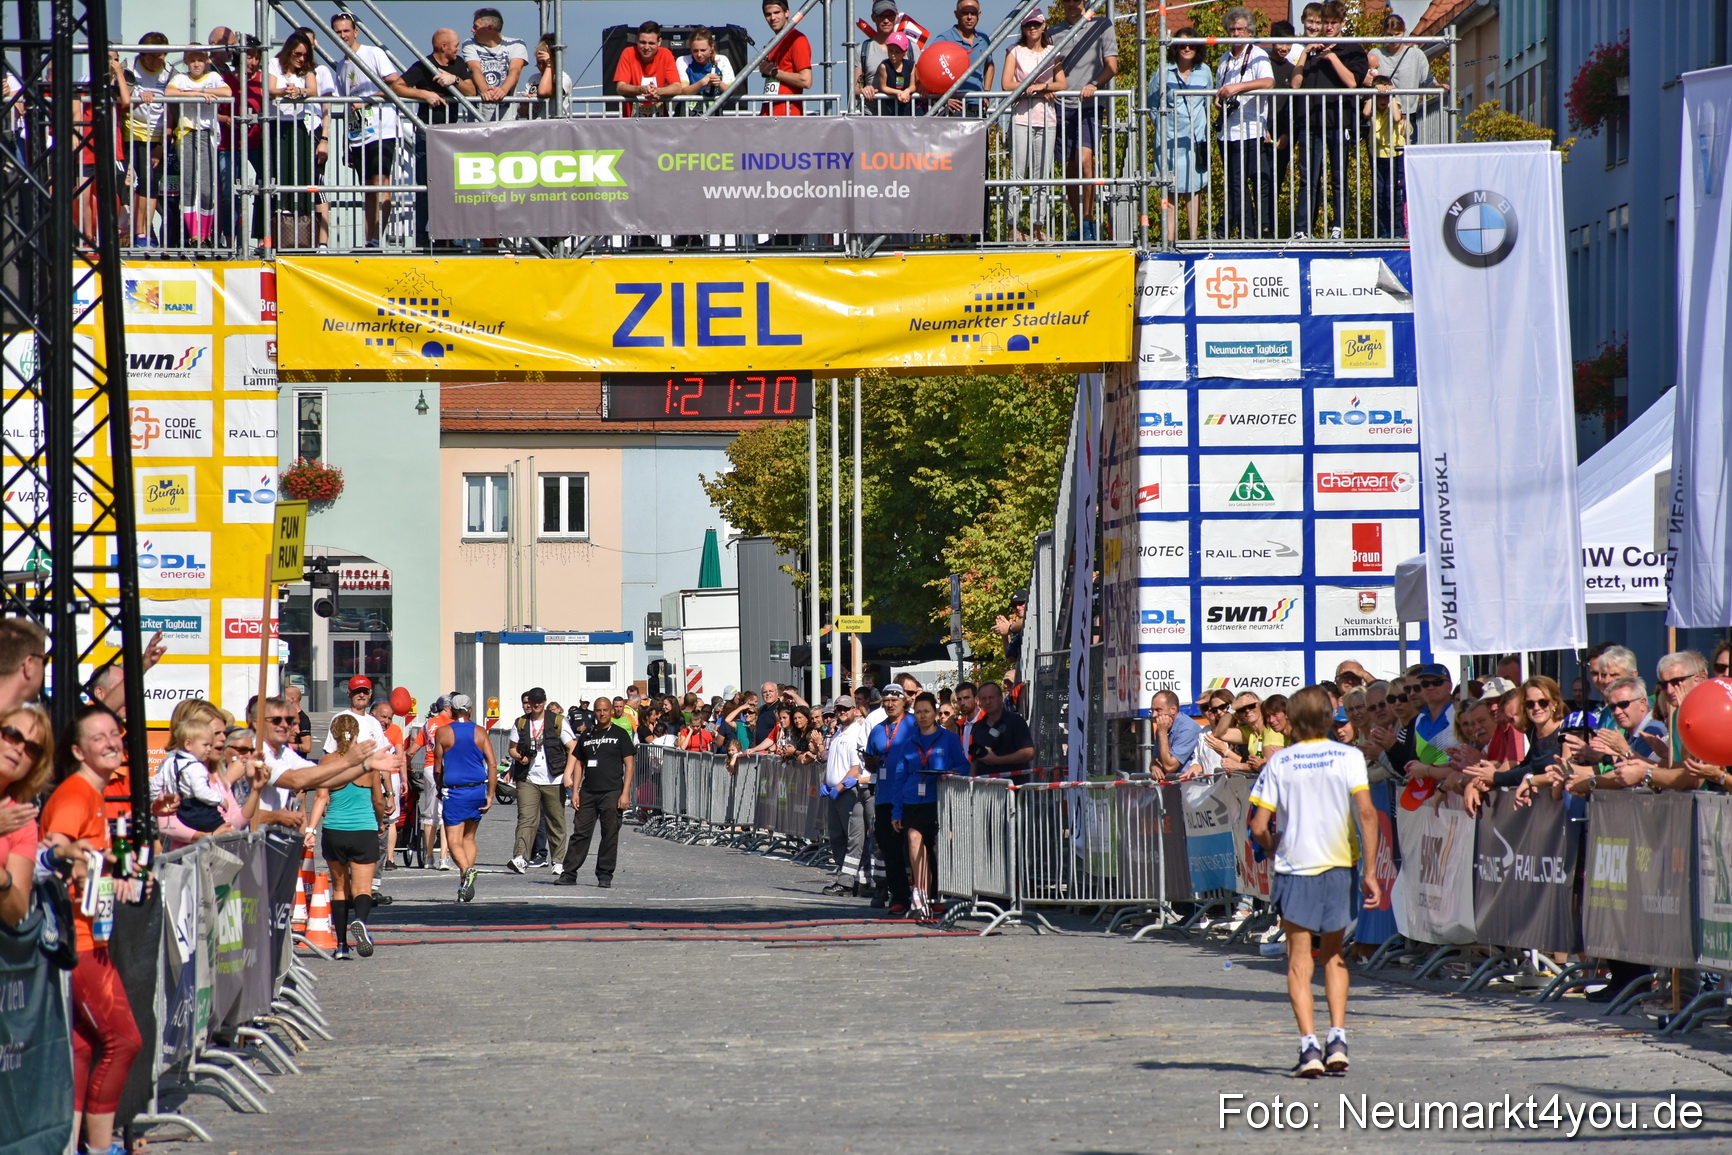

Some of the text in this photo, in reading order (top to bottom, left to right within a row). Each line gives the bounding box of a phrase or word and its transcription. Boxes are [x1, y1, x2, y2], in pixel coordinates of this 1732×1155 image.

[657, 151, 953, 172] OFFICE INDUSTRY LOUNGE
[457, 153, 620, 187] BOCK
[702, 180, 910, 199] www.bockonline.de
[454, 189, 629, 205] inspired by smart concepts
[1252, 276, 1283, 287] CODE
[260, 299, 277, 312] Bra
[612, 282, 803, 348] ZIEL
[909, 310, 1090, 332] Neumarkter Stadtlauf
[321, 318, 505, 336] Neumarkter Stadtlauf
[1209, 343, 1288, 355] Neumarkter Tagblatt
[1345, 339, 1382, 360] Burgis
[153, 371, 191, 379] neumarkt
[165, 418, 196, 428] CODE
[1229, 413, 1297, 425] VARIOTEC
[165, 429, 202, 439] CLINIC
[1139, 424, 1183, 437] energie
[1368, 424, 1413, 435] energie
[1321, 472, 1388, 488] charivari
[146, 486, 185, 505] Burgis
[280, 516, 299, 540] FUN
[111, 546, 206, 569] ÖDL
[278, 545, 298, 568] RUN
[1206, 549, 1271, 558] RAIL.ONE
[1352, 549, 1380, 563] Braun
[160, 569, 206, 579] energie
[382, 569, 389, 579] &
[1585, 574, 1659, 592] etzt, um
[1207, 605, 1268, 623] swn
[164, 618, 198, 630] Tagblatt
[1206, 622, 1284, 631] stadtwerke neumarkt
[1343, 616, 1393, 625] Neumarkter
[1142, 623, 1186, 635] energie
[1335, 625, 1400, 636] Lammsbräu
[1145, 670, 1175, 680] CODE
[1145, 681, 1181, 691] CLINIC
[1233, 675, 1300, 688] VARIOTEC
[583, 737, 619, 747] SECURITY
[1293, 749, 1346, 760] Neumarkter
[1293, 759, 1334, 771] Stadtlauf
